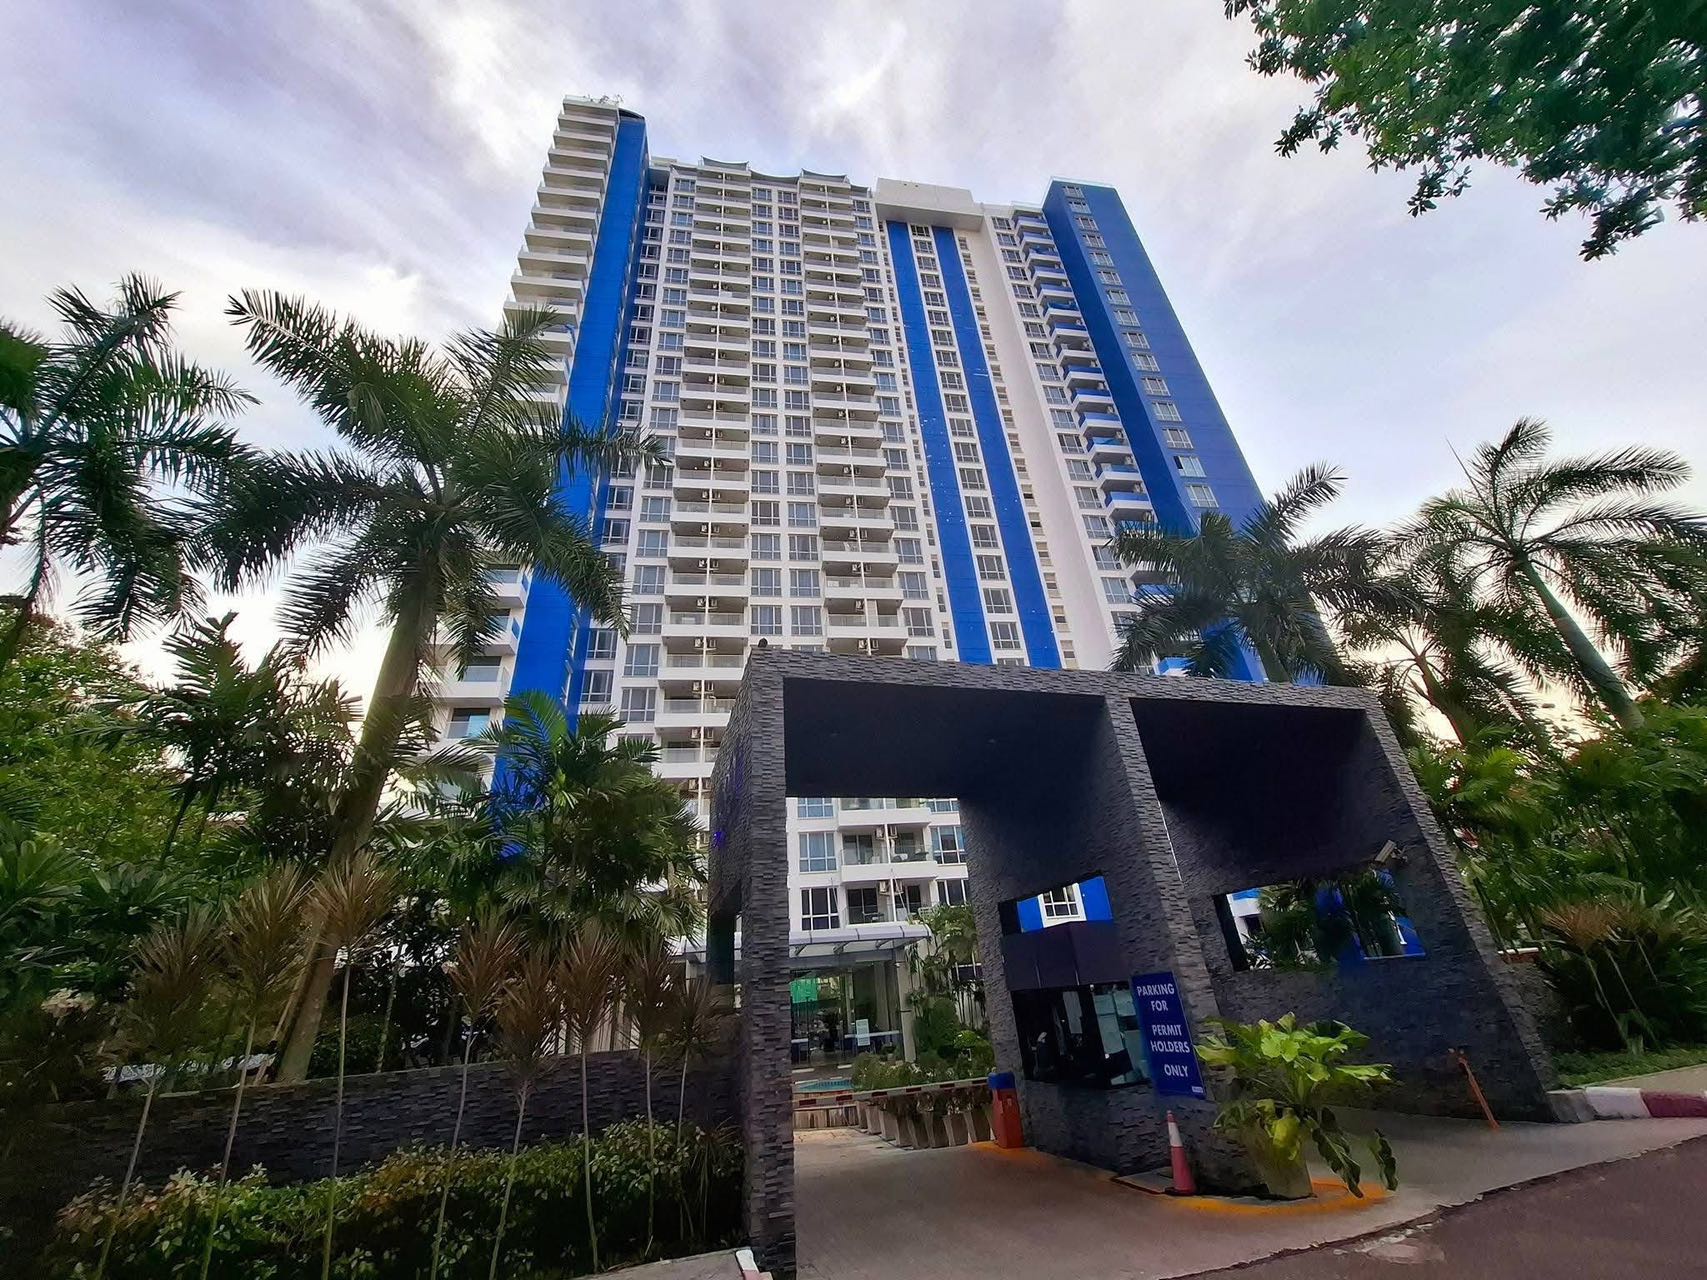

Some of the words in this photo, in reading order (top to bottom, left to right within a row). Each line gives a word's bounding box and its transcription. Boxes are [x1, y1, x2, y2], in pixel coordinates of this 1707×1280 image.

[1137, 983, 1175, 996] PARKING
[1151, 1000, 1168, 1011] FOR
[1152, 1024, 1182, 1036] PERMIT
[1150, 1041, 1190, 1053] HOLDERS
[1164, 1064, 1188, 1077] ONLY
